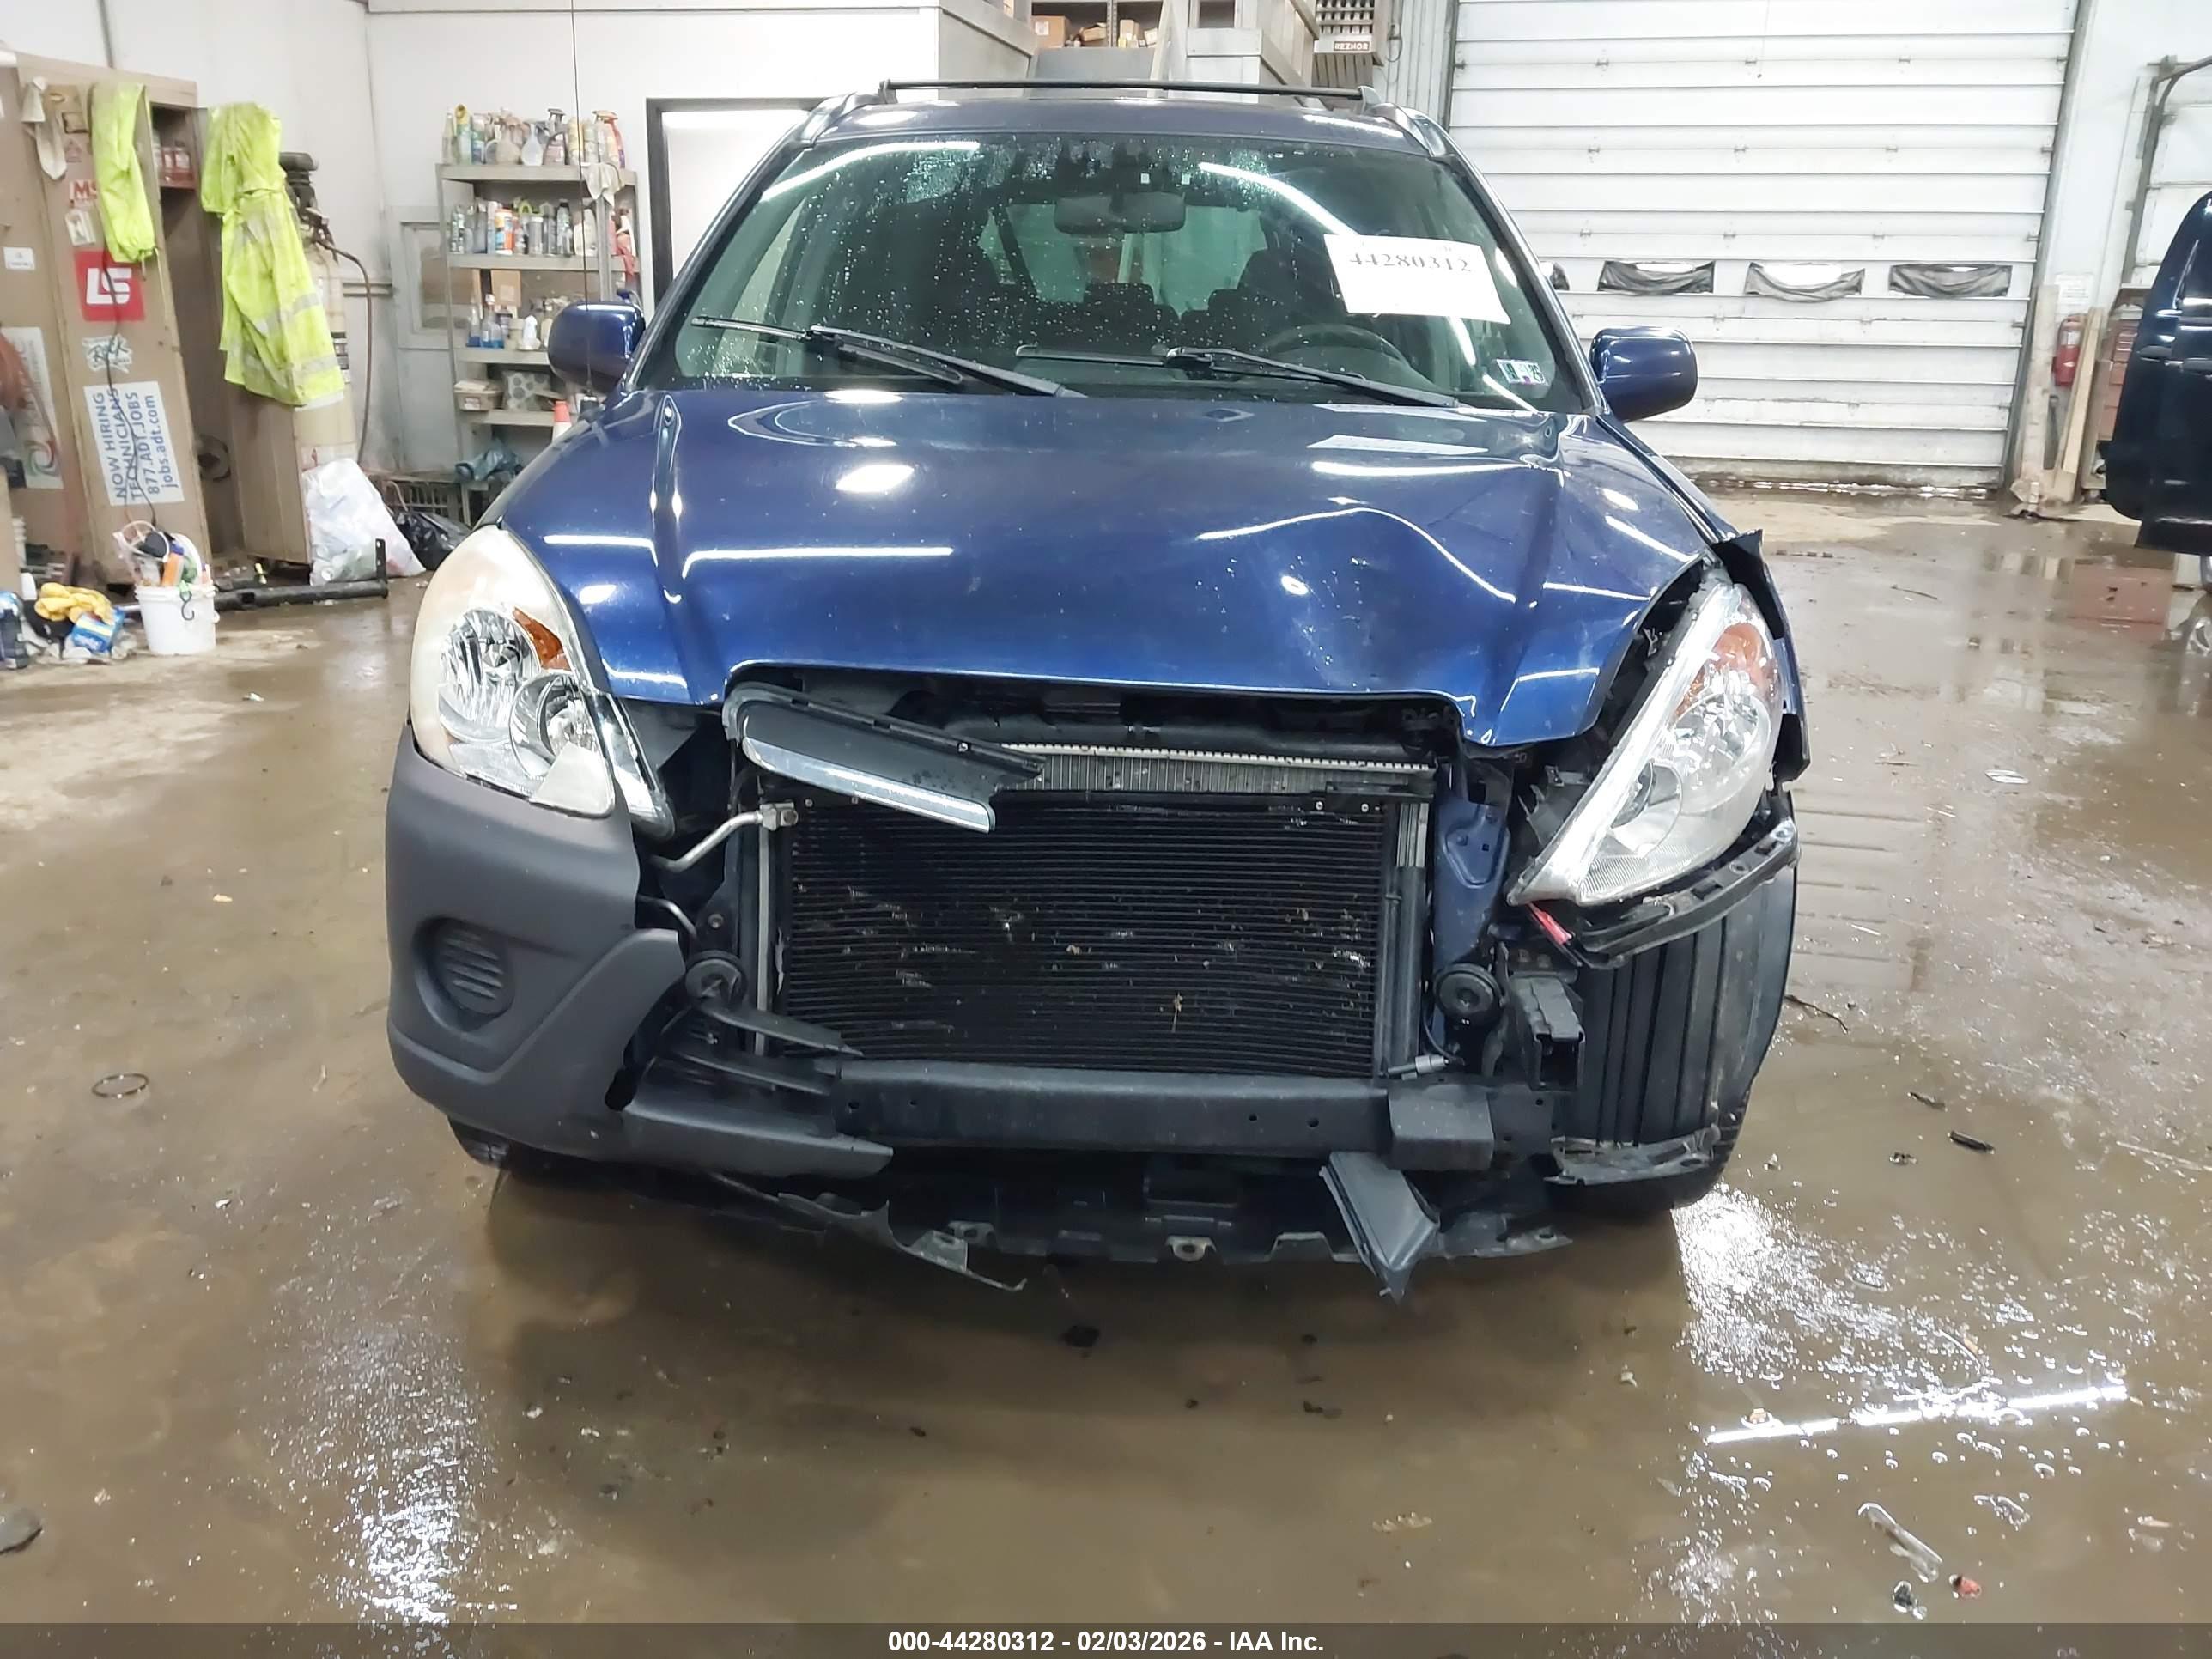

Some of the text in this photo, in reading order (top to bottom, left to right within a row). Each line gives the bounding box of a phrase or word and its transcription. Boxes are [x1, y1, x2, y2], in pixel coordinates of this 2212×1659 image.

[1350, 252, 1471, 271] 44280312
[94, 392, 127, 499] NOW HIRING
